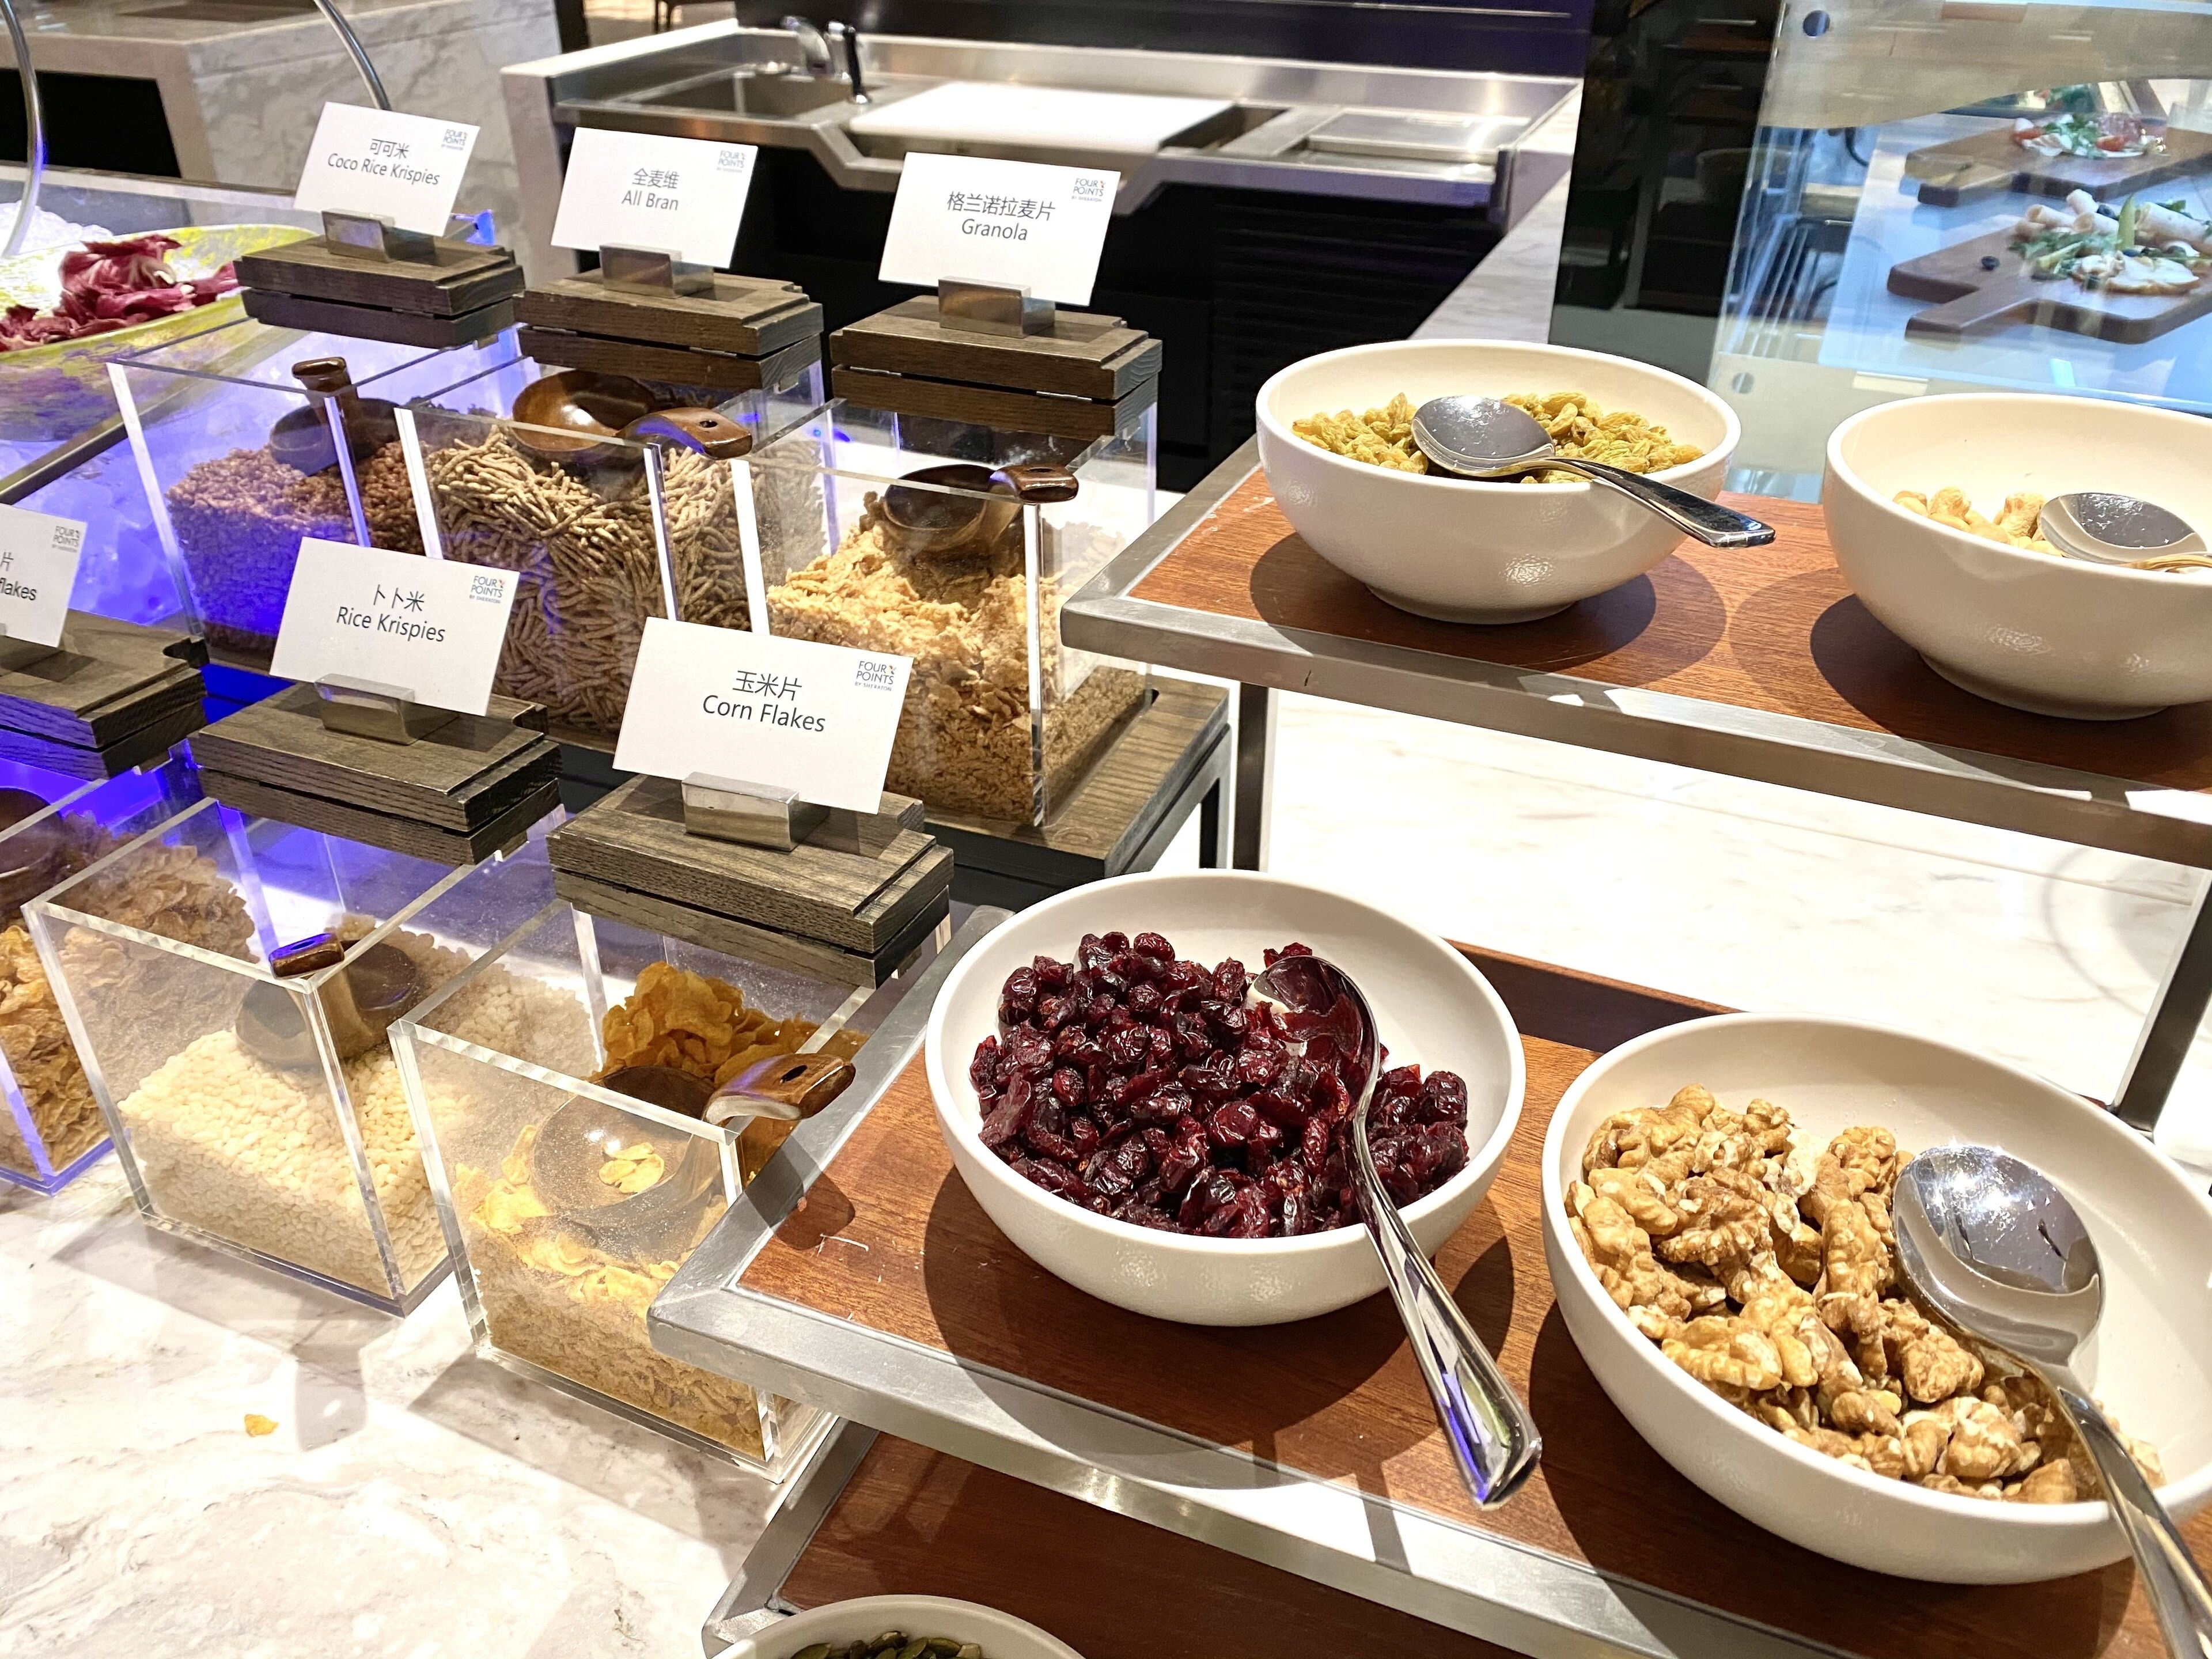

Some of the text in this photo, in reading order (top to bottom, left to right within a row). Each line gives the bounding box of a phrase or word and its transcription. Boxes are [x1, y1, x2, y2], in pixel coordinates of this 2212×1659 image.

[370, 139, 409, 158] 可可米
[328, 153, 440, 185] Coco Rice Krispies
[718, 158, 744, 168] POINTS
[632, 168, 679, 188] 全麦维
[1075, 178, 1098, 187] FOUR
[622, 190, 678, 210] All Bran
[1073, 186, 1104, 196] POINTS
[947, 191, 1055, 221] 格兰诺拉麦片
[962, 219, 1027, 240] Granola
[53, 534, 79, 547] POINTS
[473, 575, 497, 588] FOUR
[470, 584, 503, 599] POINTS
[336, 607, 445, 642] Rice Krispies
[858, 661, 887, 674] FOUR
[733, 671, 802, 700] 玉米片
[855, 670, 894, 685] POINTS
[703, 695, 825, 732] Corn Flakes
